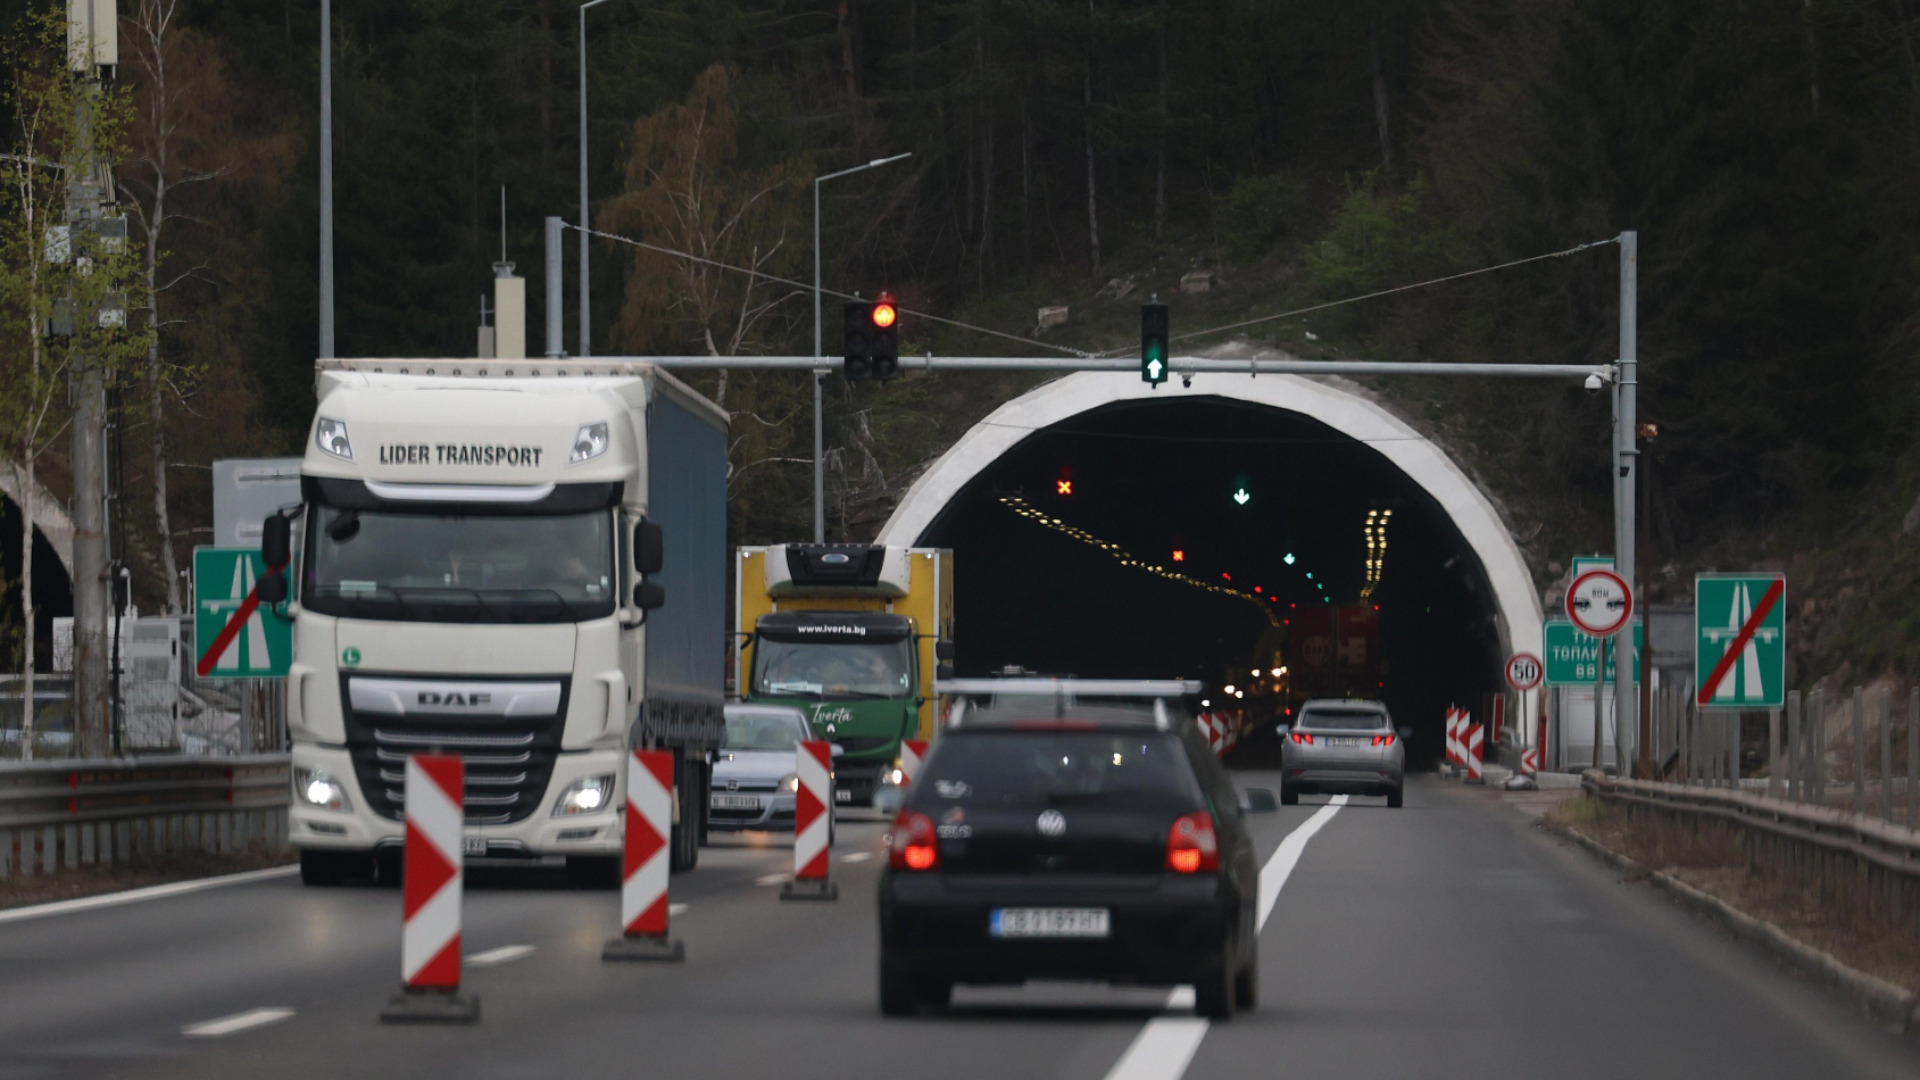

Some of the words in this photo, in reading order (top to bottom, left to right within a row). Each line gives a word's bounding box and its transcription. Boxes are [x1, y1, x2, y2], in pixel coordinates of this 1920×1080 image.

[380, 445, 430, 465] LIDER
[436, 445, 543, 467] TRANSPORT
[798, 625, 866, 635] www.iverta.bg
[1514, 662, 1535, 680] 50
[417, 692, 491, 705] DAF
